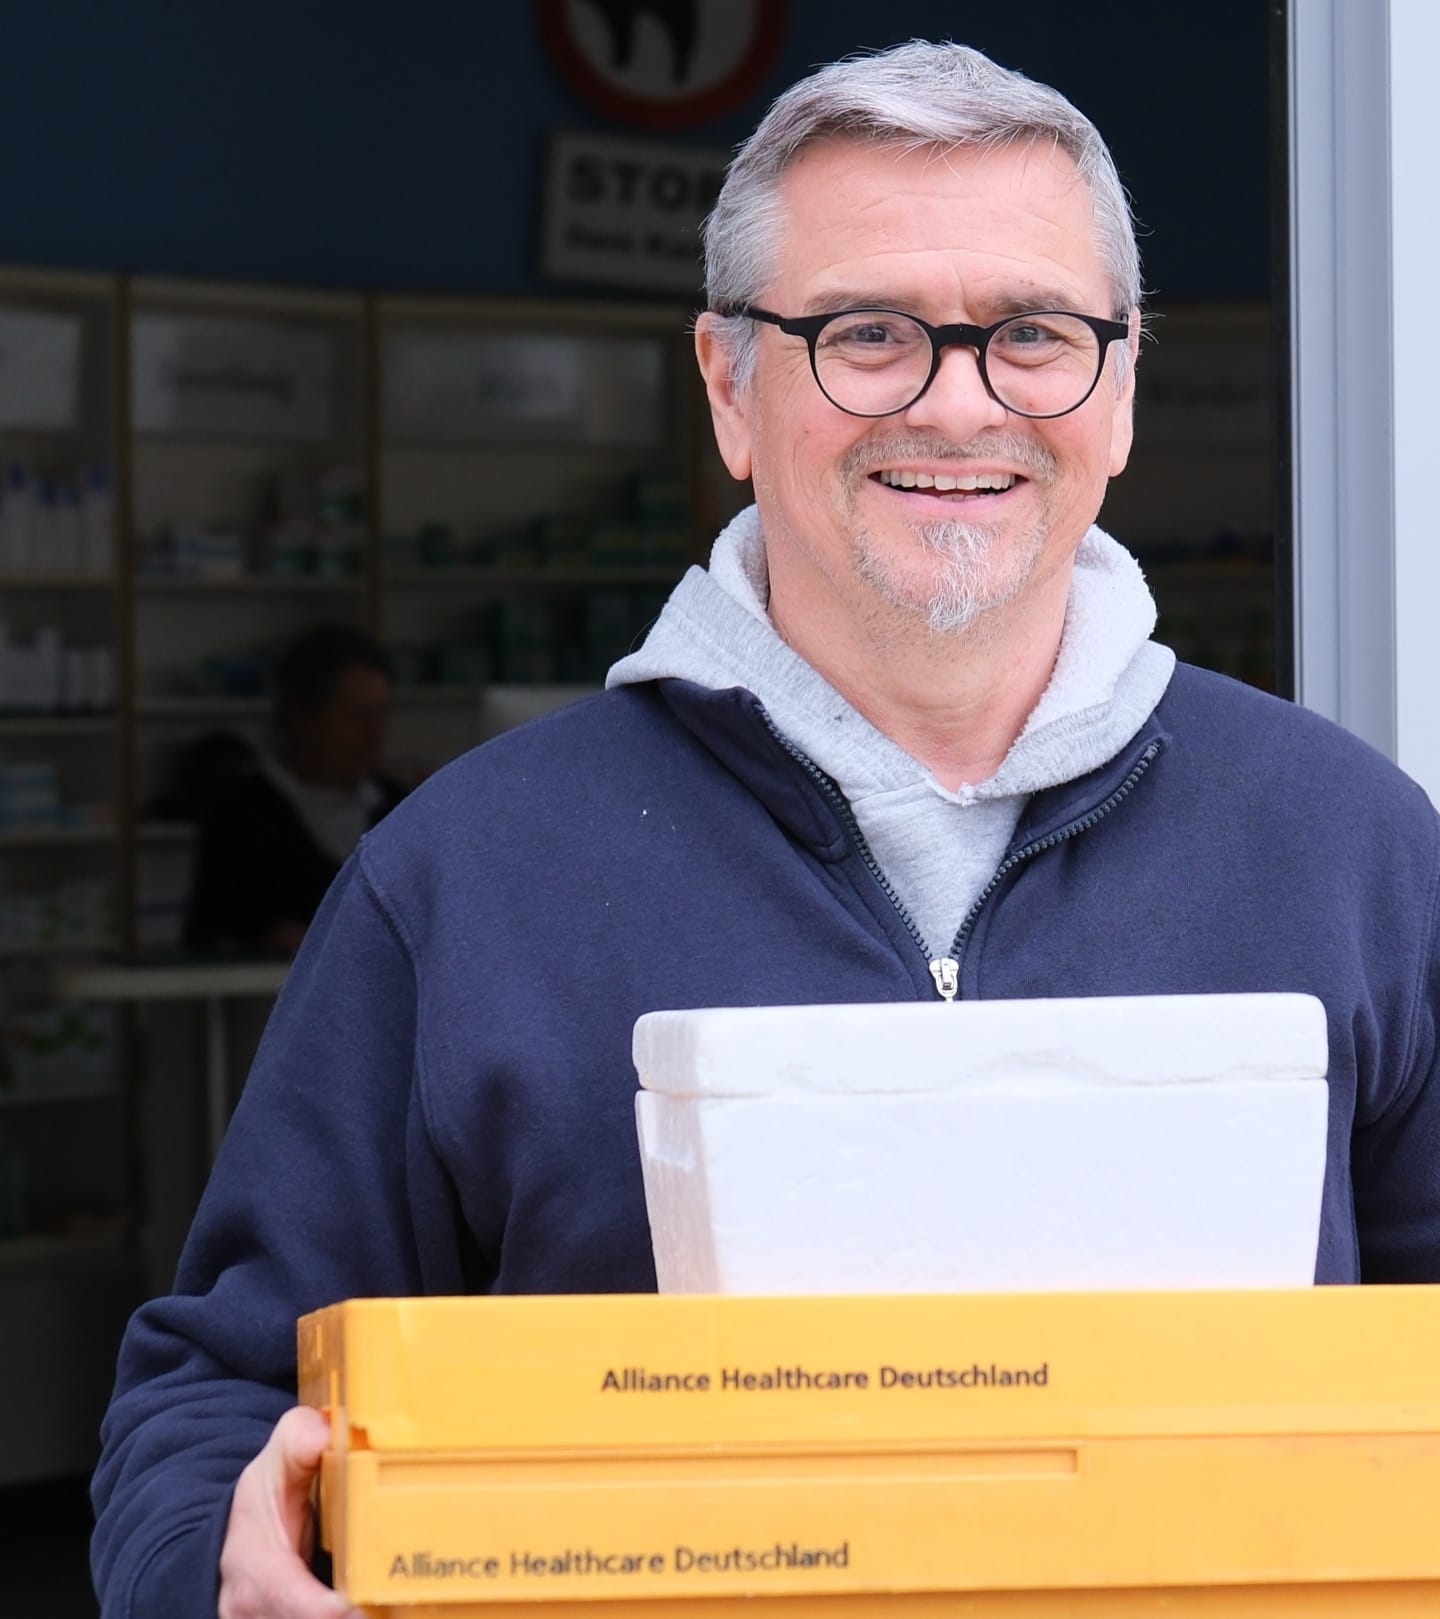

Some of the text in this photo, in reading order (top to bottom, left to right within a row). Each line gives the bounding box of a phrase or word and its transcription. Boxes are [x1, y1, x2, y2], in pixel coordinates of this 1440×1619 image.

[601, 1362, 1048, 1392] Alliance Healthcare Deutschland
[388, 1541, 849, 1579] Alliance Healthcare Deutschland
